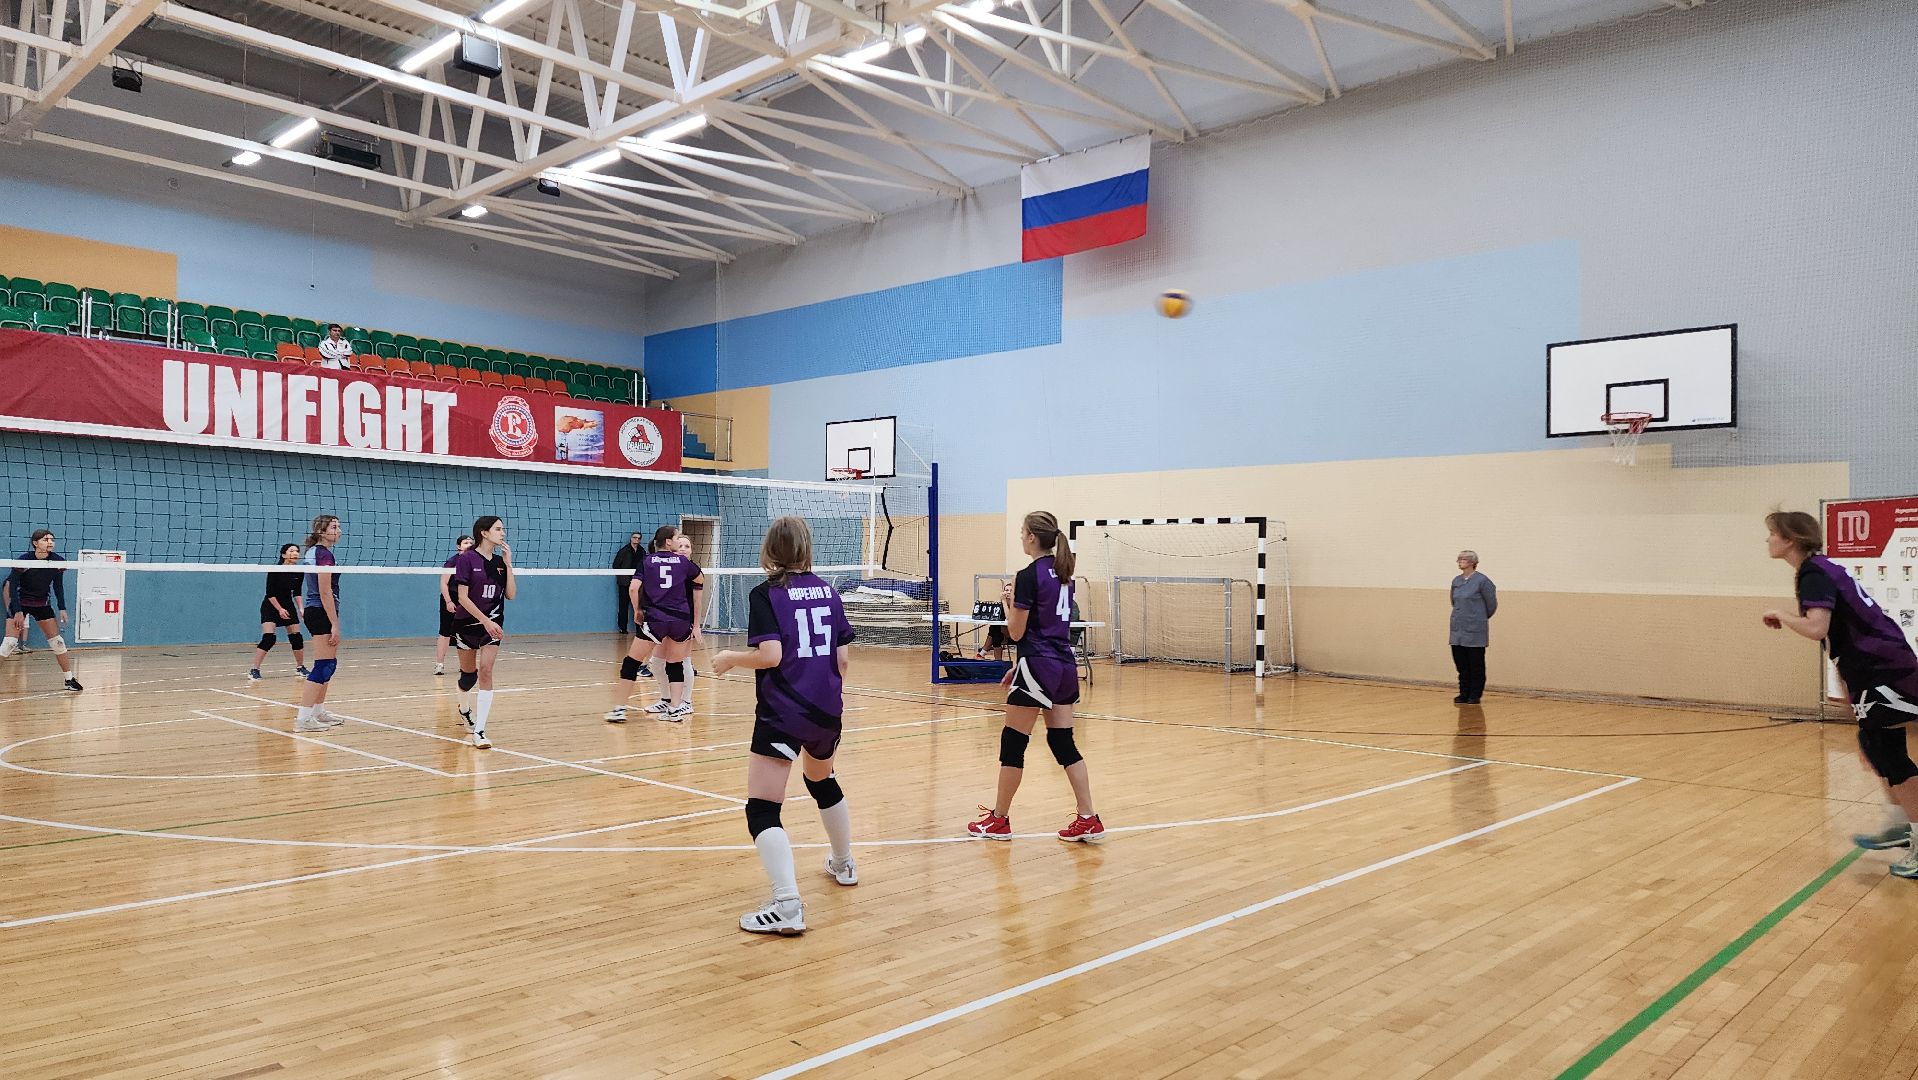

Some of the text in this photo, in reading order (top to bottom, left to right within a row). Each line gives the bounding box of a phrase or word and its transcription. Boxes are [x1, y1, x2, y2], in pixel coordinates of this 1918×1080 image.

[162, 360, 457, 455] UNIFIGHT
[1837, 510, 1870, 542] ГТО
[482, 585, 496, 598] 10
[660, 566, 672, 588] 5
[1056, 584, 1070, 621] 4
[795, 606, 831, 657] 15
